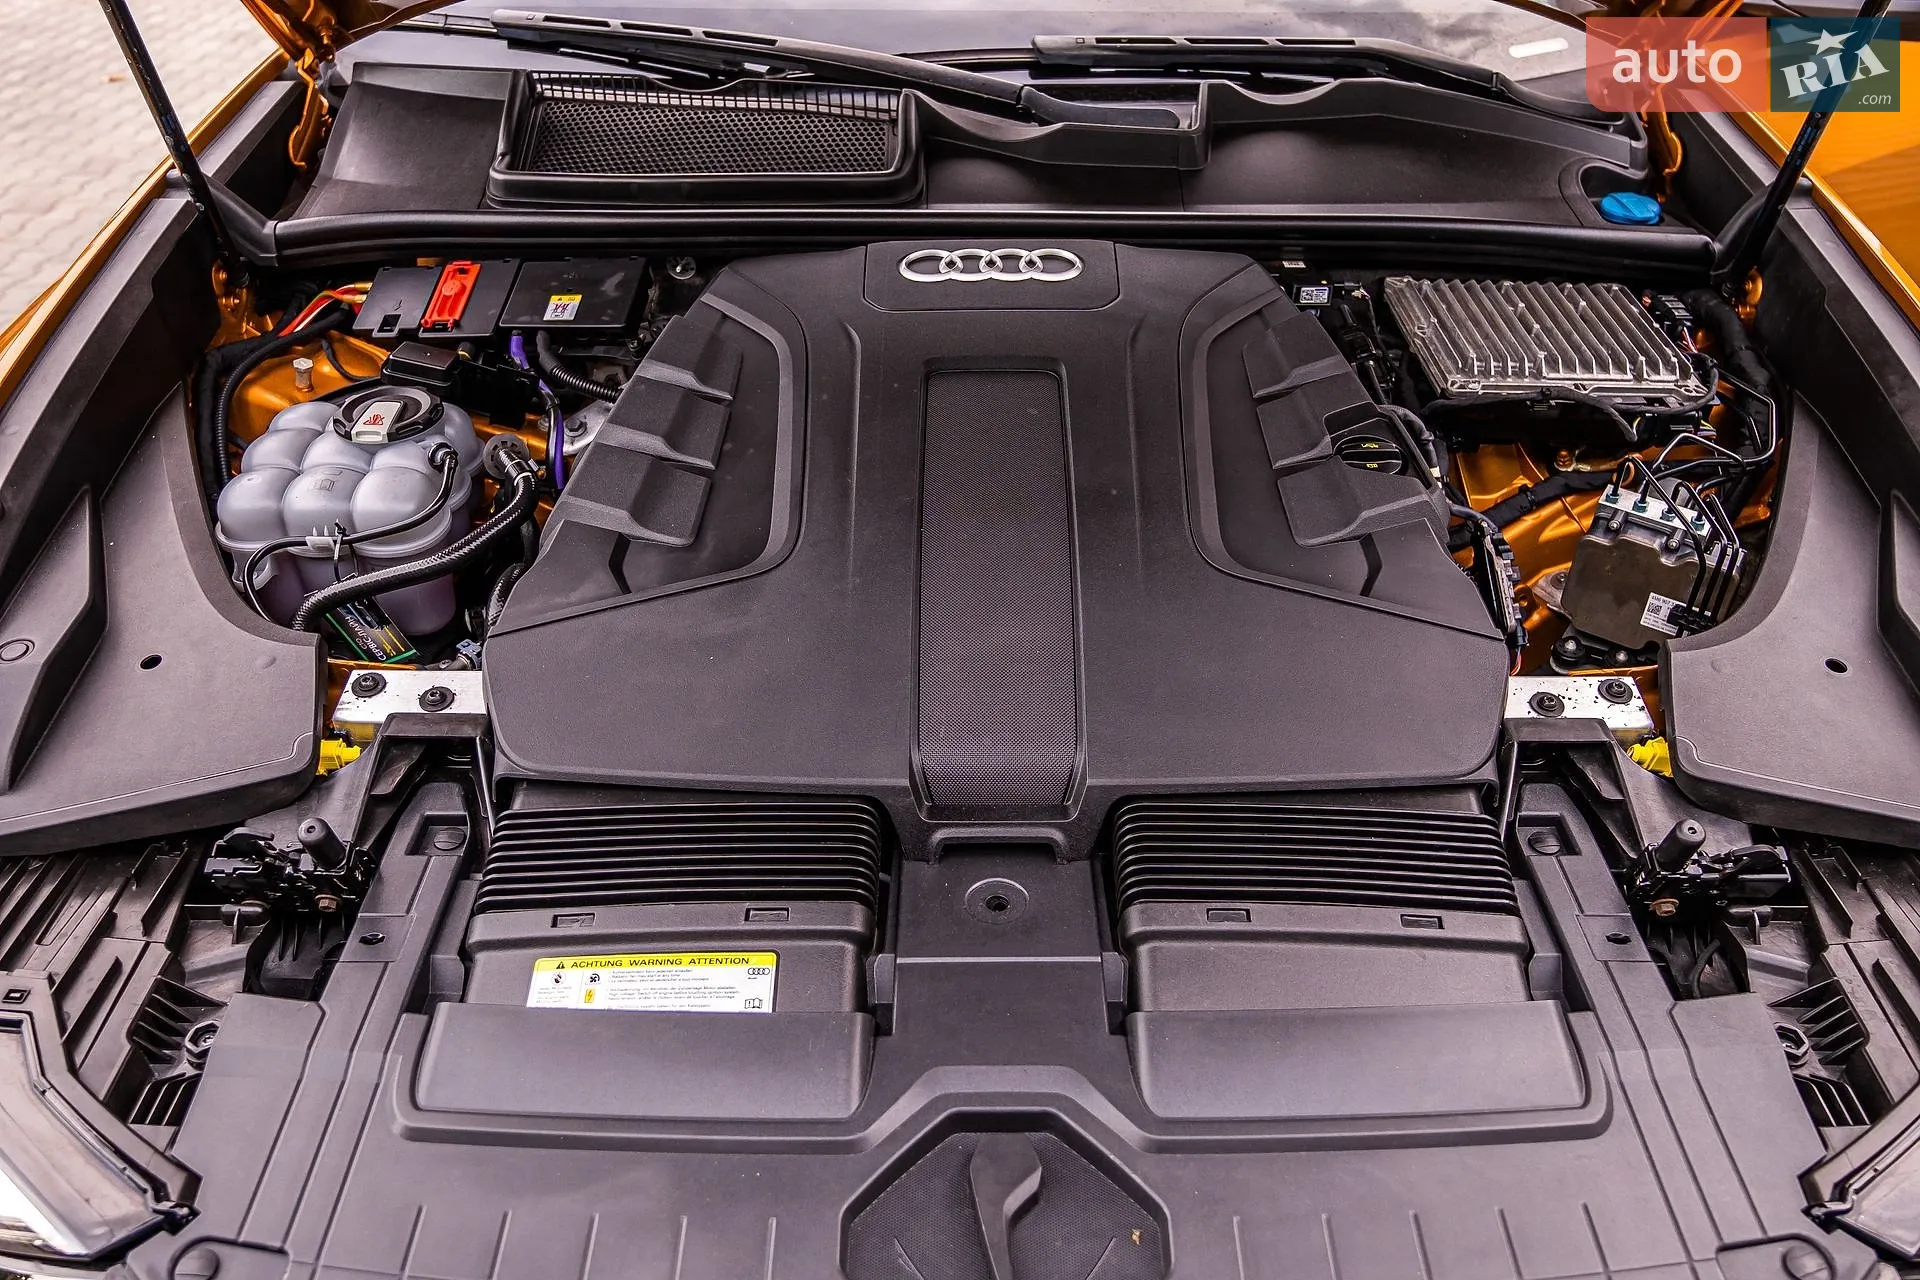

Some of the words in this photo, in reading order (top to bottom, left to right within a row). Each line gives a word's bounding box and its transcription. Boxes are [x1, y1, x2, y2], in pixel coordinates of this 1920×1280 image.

[571, 959, 623, 969] ACHTUNG
[629, 958, 682, 967] WARNING
[688, 957, 750, 966] ATTENTION
